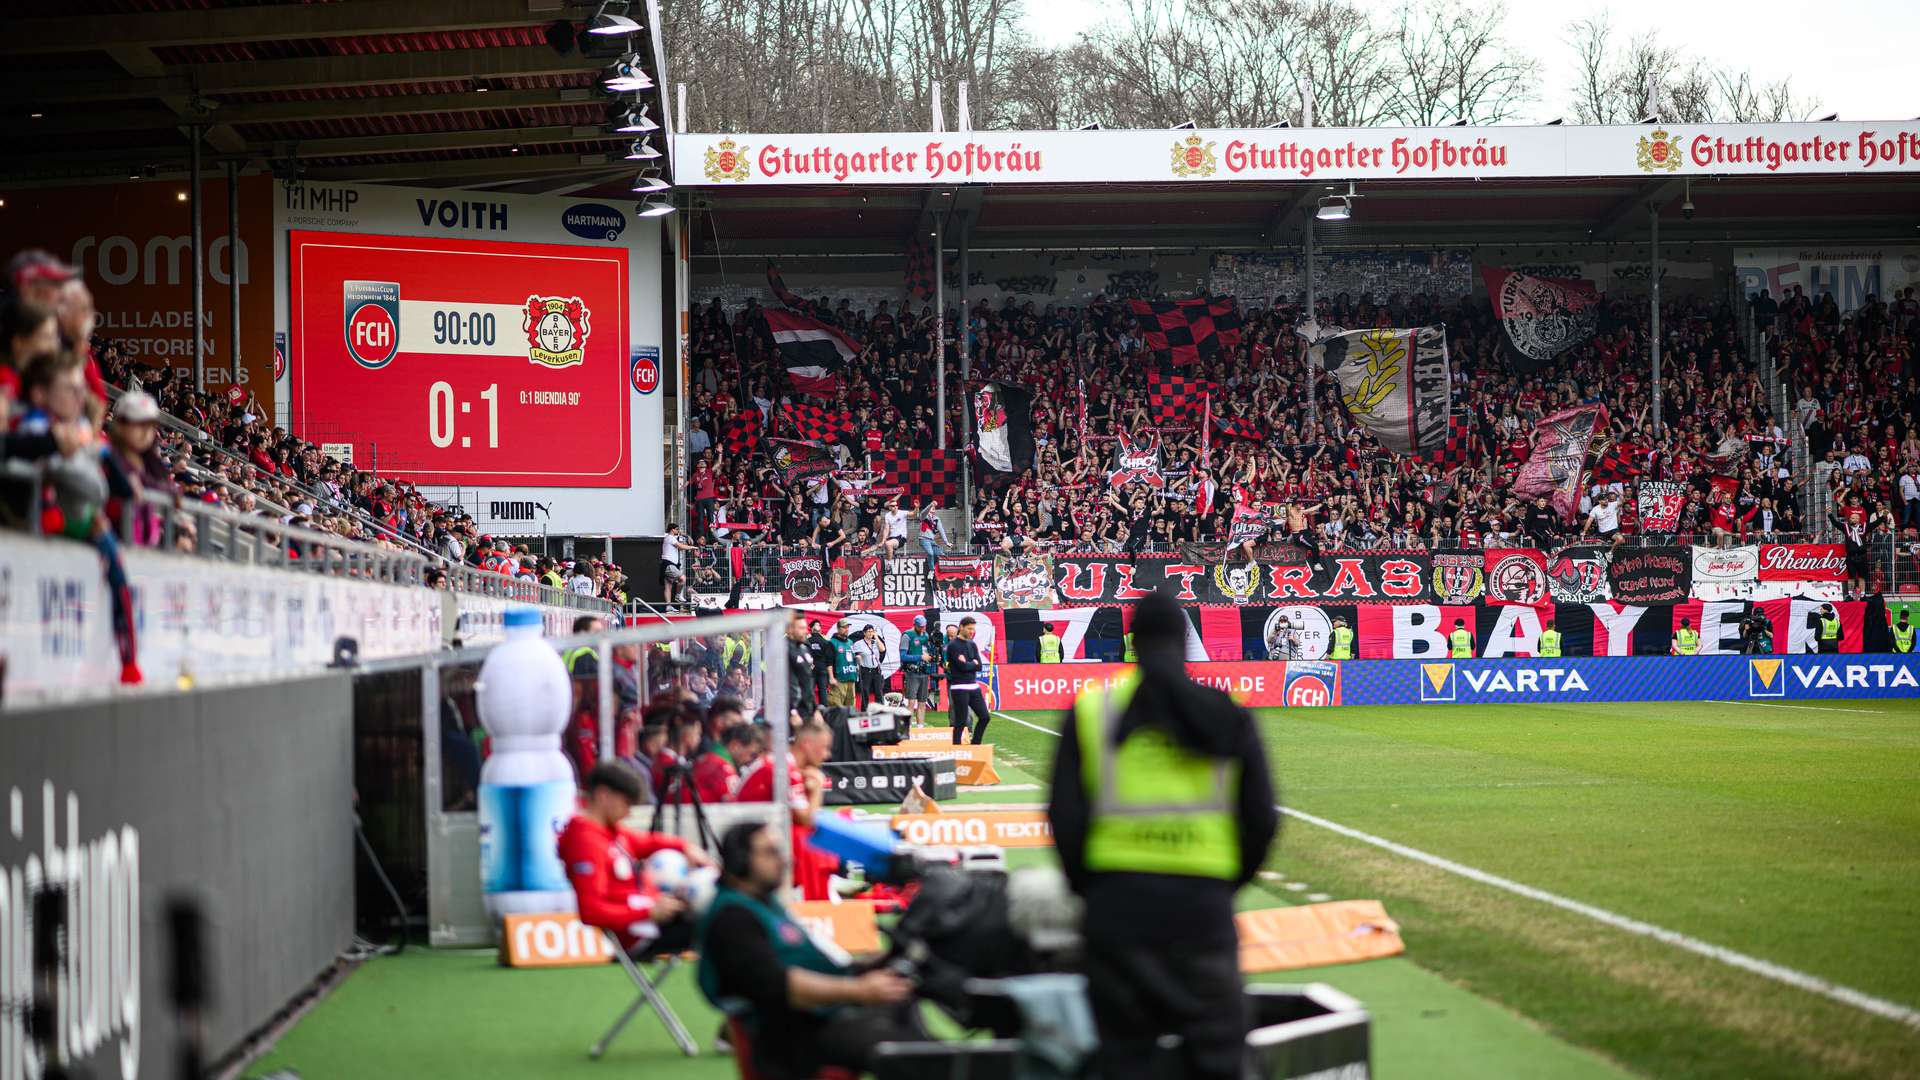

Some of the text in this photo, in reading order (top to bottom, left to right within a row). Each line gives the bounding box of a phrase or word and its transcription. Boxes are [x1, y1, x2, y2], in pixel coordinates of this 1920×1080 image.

[759, 142, 1041, 182] Stuttgarter Hofbräu
[1225, 137, 1508, 177] Stuttgarter Hofbräu
[1691, 134, 1850, 171] Stuttgarter
[310, 187, 359, 212] MHP
[294, 216, 325, 225] PORSCHE
[416, 198, 508, 231] VOITH
[567, 213, 621, 228] HARTMANN
[72, 235, 249, 285] roma
[547, 302, 563, 310] 1904
[94, 310, 213, 328] OLLLADEN
[433, 310, 496, 346] 90:00
[356, 321, 390, 347] FCH
[542, 328, 570, 337] BAYER
[534, 349, 578, 363] Leverkusen
[636, 368, 655, 383] FCH
[519, 390, 581, 406] 0:1 BUENDIA 90'
[429, 380, 499, 449] 0:1
[491, 501, 535, 520] PUMA
[884, 558, 926, 575] WEST
[1760, 546, 1848, 577] Rheindor
[884, 575, 926, 591] SIDE
[884, 591, 926, 606] BOYZ
[1463, 669, 1590, 693] VARTA
[1792, 664, 1918, 689] VARTA
[1292, 686, 1326, 704] FCH
[896, 818, 987, 843] roma
[514, 920, 614, 962] rom
